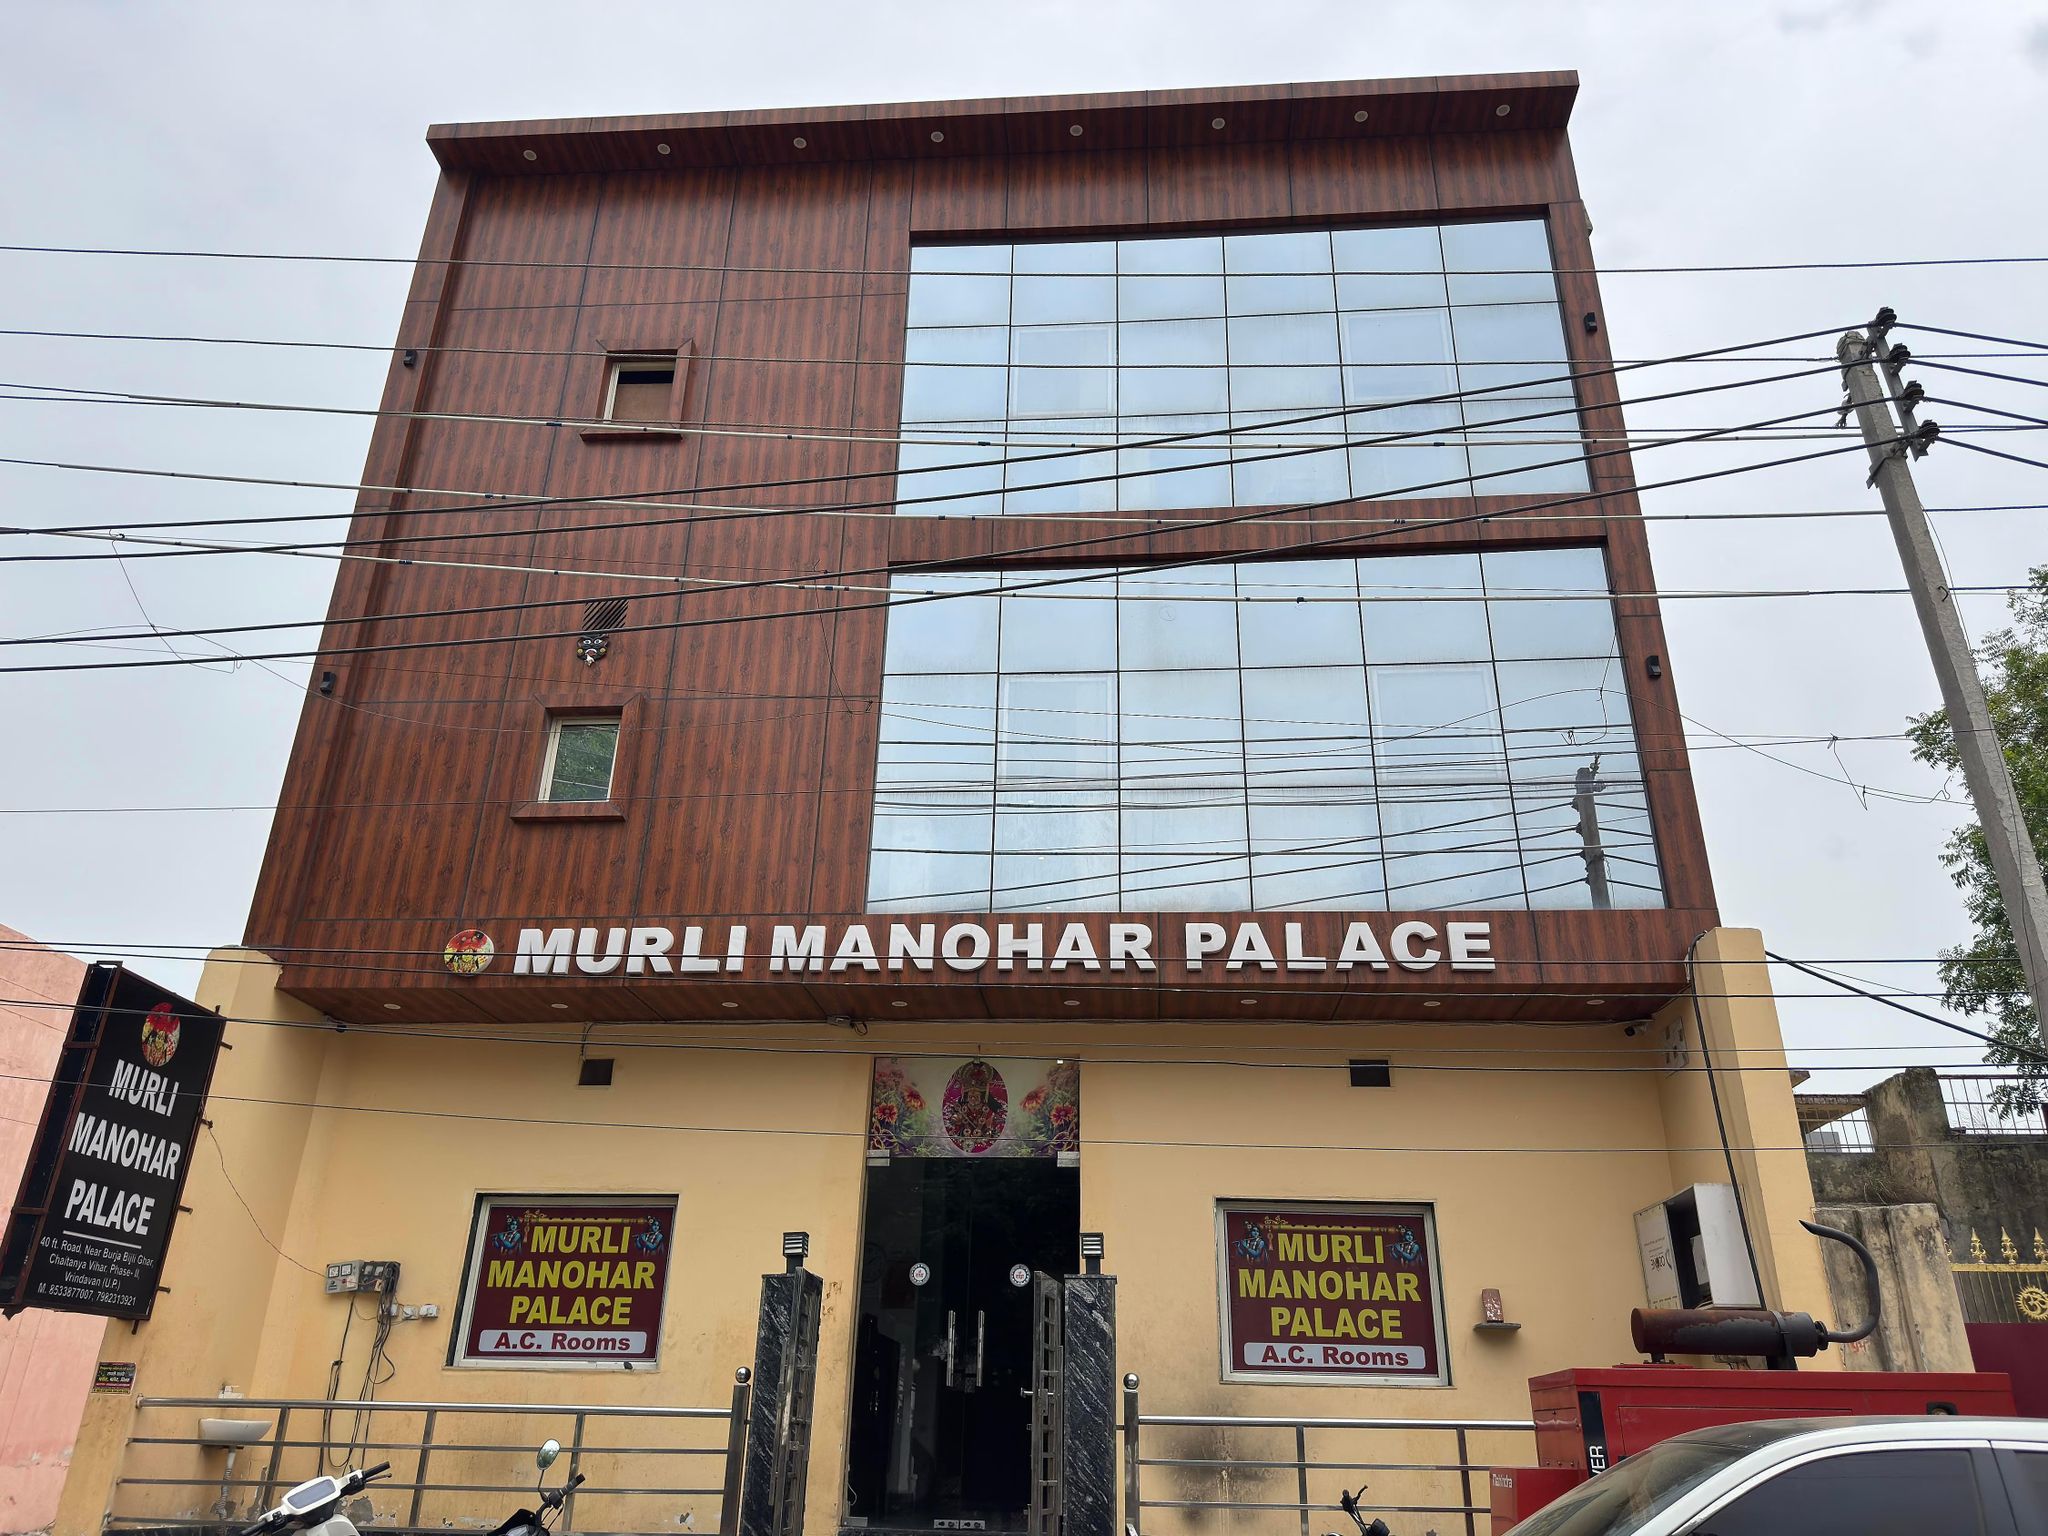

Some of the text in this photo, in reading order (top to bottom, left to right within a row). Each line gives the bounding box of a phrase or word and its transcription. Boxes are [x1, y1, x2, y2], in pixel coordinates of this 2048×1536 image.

[513, 920, 1496, 975] MURLI MANOHAR PALACE
[108, 1059, 180, 1117] MURLI
[68, 1112, 181, 1180] MANOHAR
[64, 1178, 155, 1236] PALACE
[40, 1236, 50, 1248] 40
[51, 1237, 59, 1249] ft.
[84, 1244, 101, 1258] Near
[103, 1247, 121, 1263] Burja
[530, 1226, 631, 1254] MURLI
[1277, 1232, 1385, 1264] MURLI
[49, 1253, 86, 1271] Chaitanya
[487, 1260, 656, 1289] MANOHAR
[38, 1282, 47, 1294] M.
[65, 1270, 101, 1287] Vrindavan
[1238, 1268, 1422, 1302] MANOHAR
[509, 1296, 633, 1325] PALACE
[1270, 1307, 1403, 1339] PALACE
[494, 1332, 631, 1351] A.C. Rooms
[1261, 1345, 1409, 1367] A.C. Rooms
